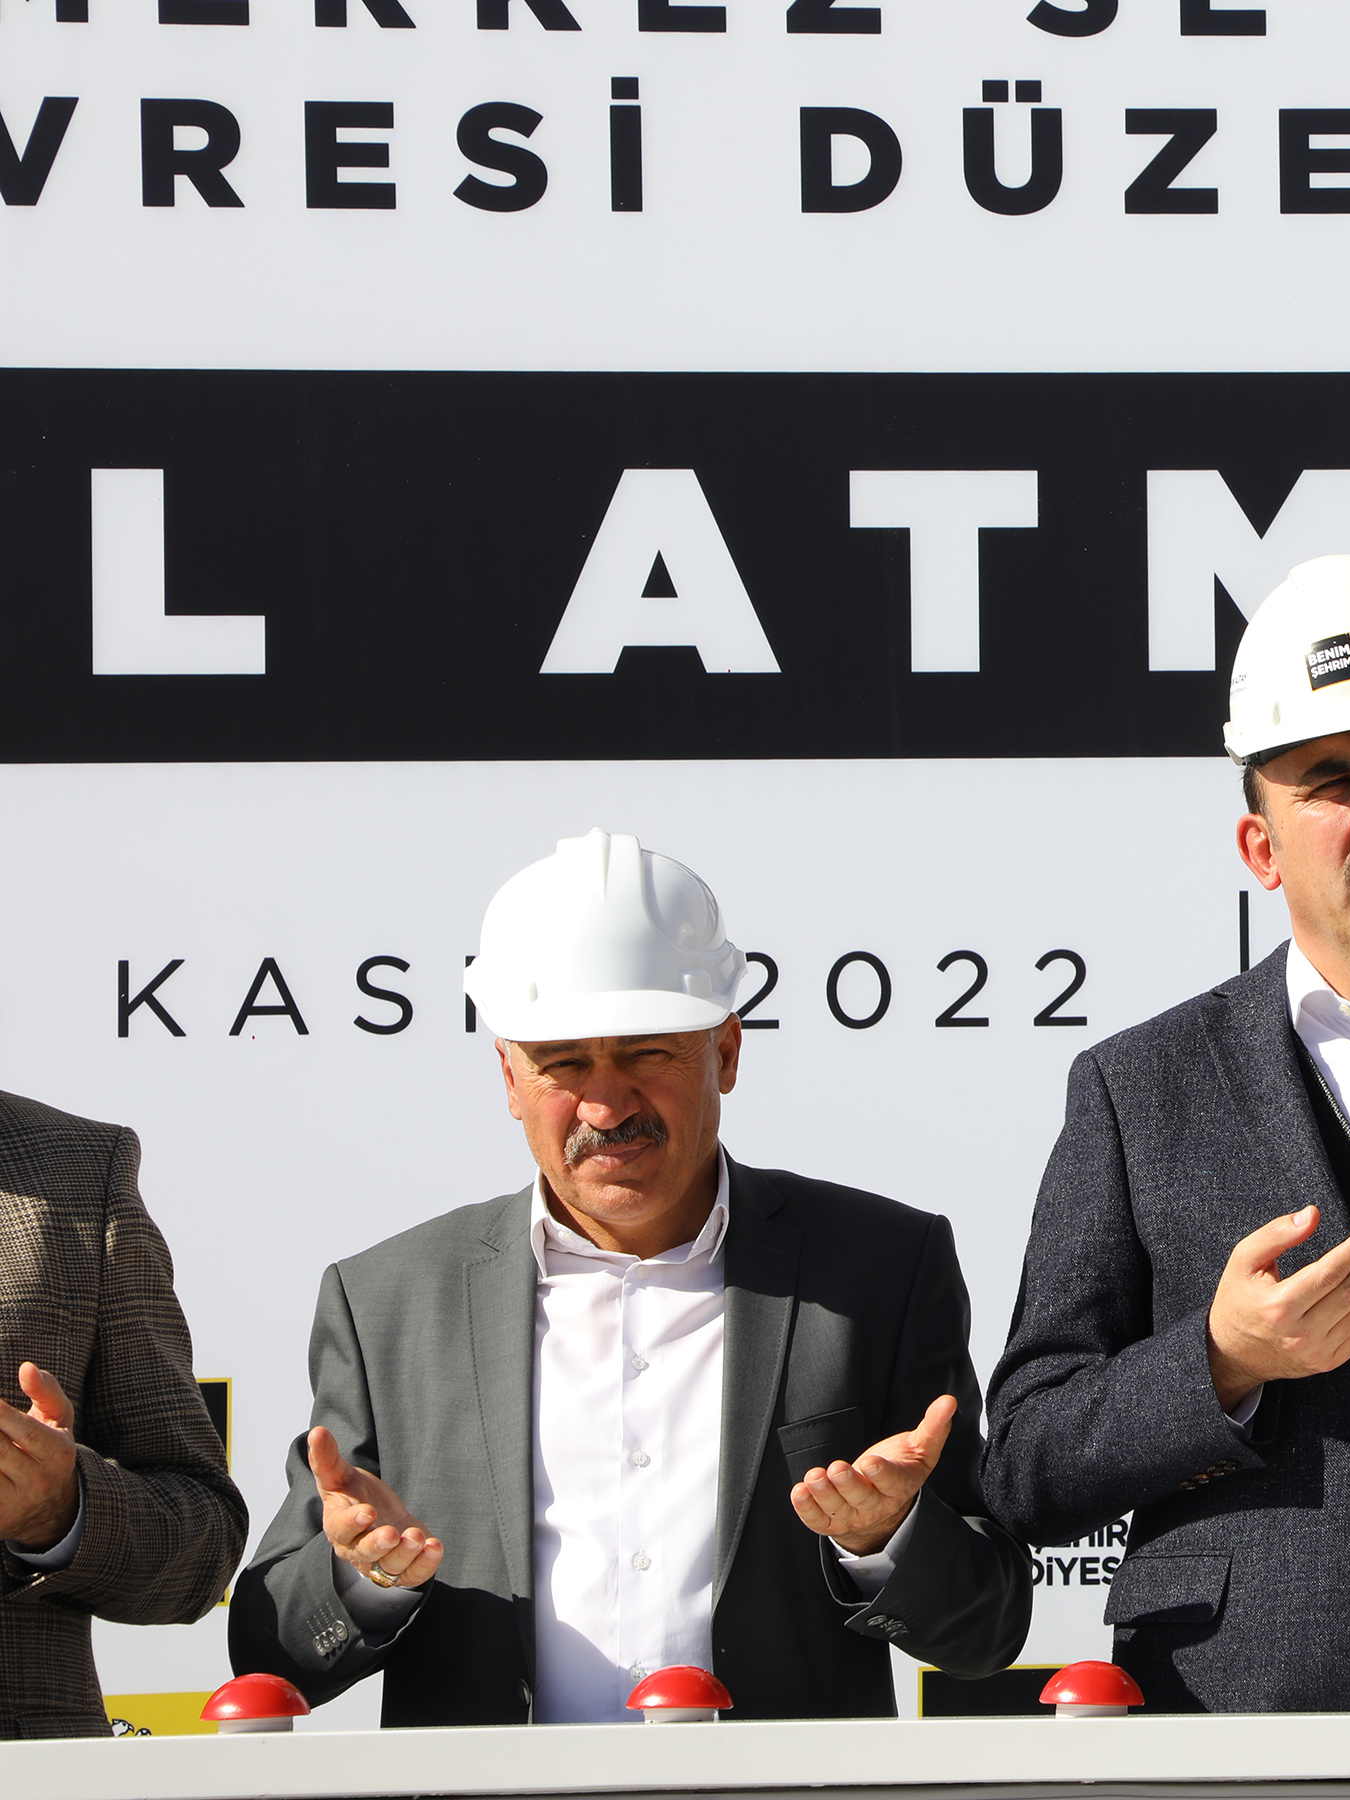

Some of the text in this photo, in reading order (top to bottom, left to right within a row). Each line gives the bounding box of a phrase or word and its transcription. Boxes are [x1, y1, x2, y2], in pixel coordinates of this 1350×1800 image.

[0, 76, 644, 213] VRESİ
[1307, 643, 1350, 667] BENİM
[117, 954, 477, 1038] KASI
[740, 948, 1088, 1030] 2022
